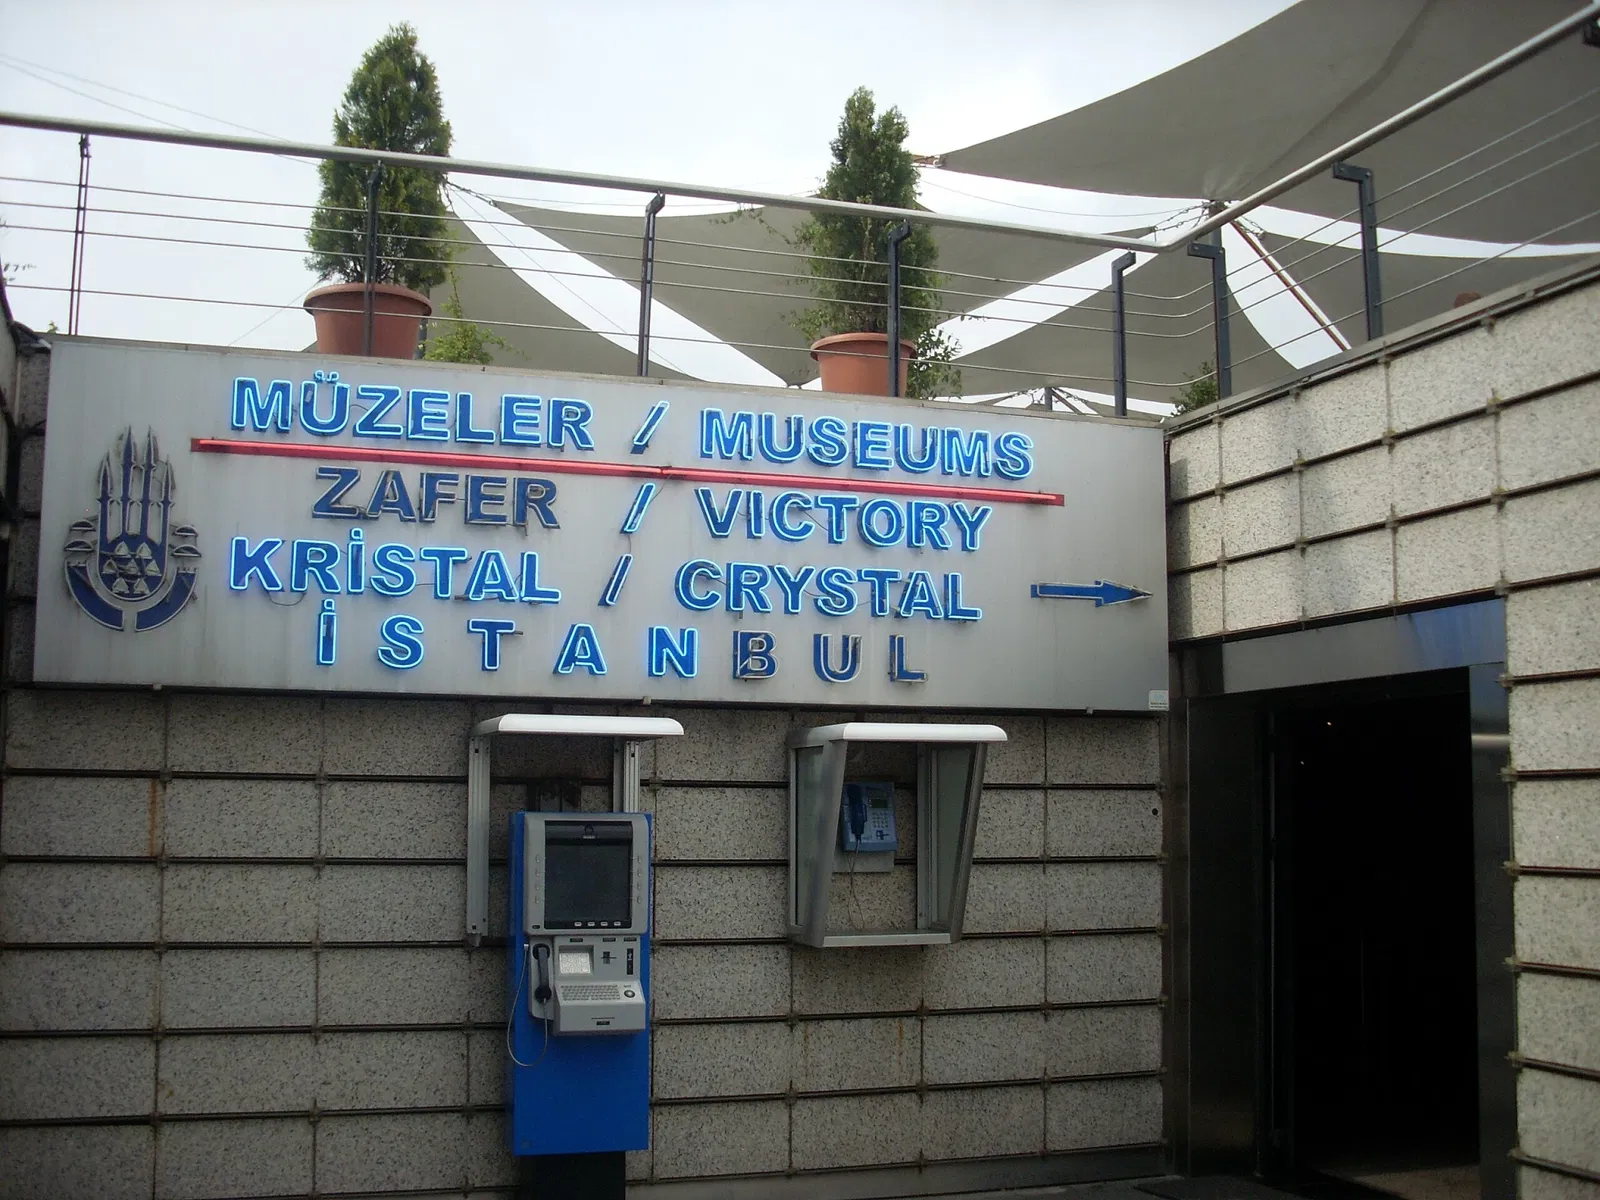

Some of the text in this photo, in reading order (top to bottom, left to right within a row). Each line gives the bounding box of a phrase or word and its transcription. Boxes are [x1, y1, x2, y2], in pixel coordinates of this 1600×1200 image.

[231, 370, 1035, 480] MÜZELER / MUSEUMS
[312, 466, 992, 551] ZAFER / VICTORY
[230, 528, 983, 622] KRİSTAL / CRYSTAL
